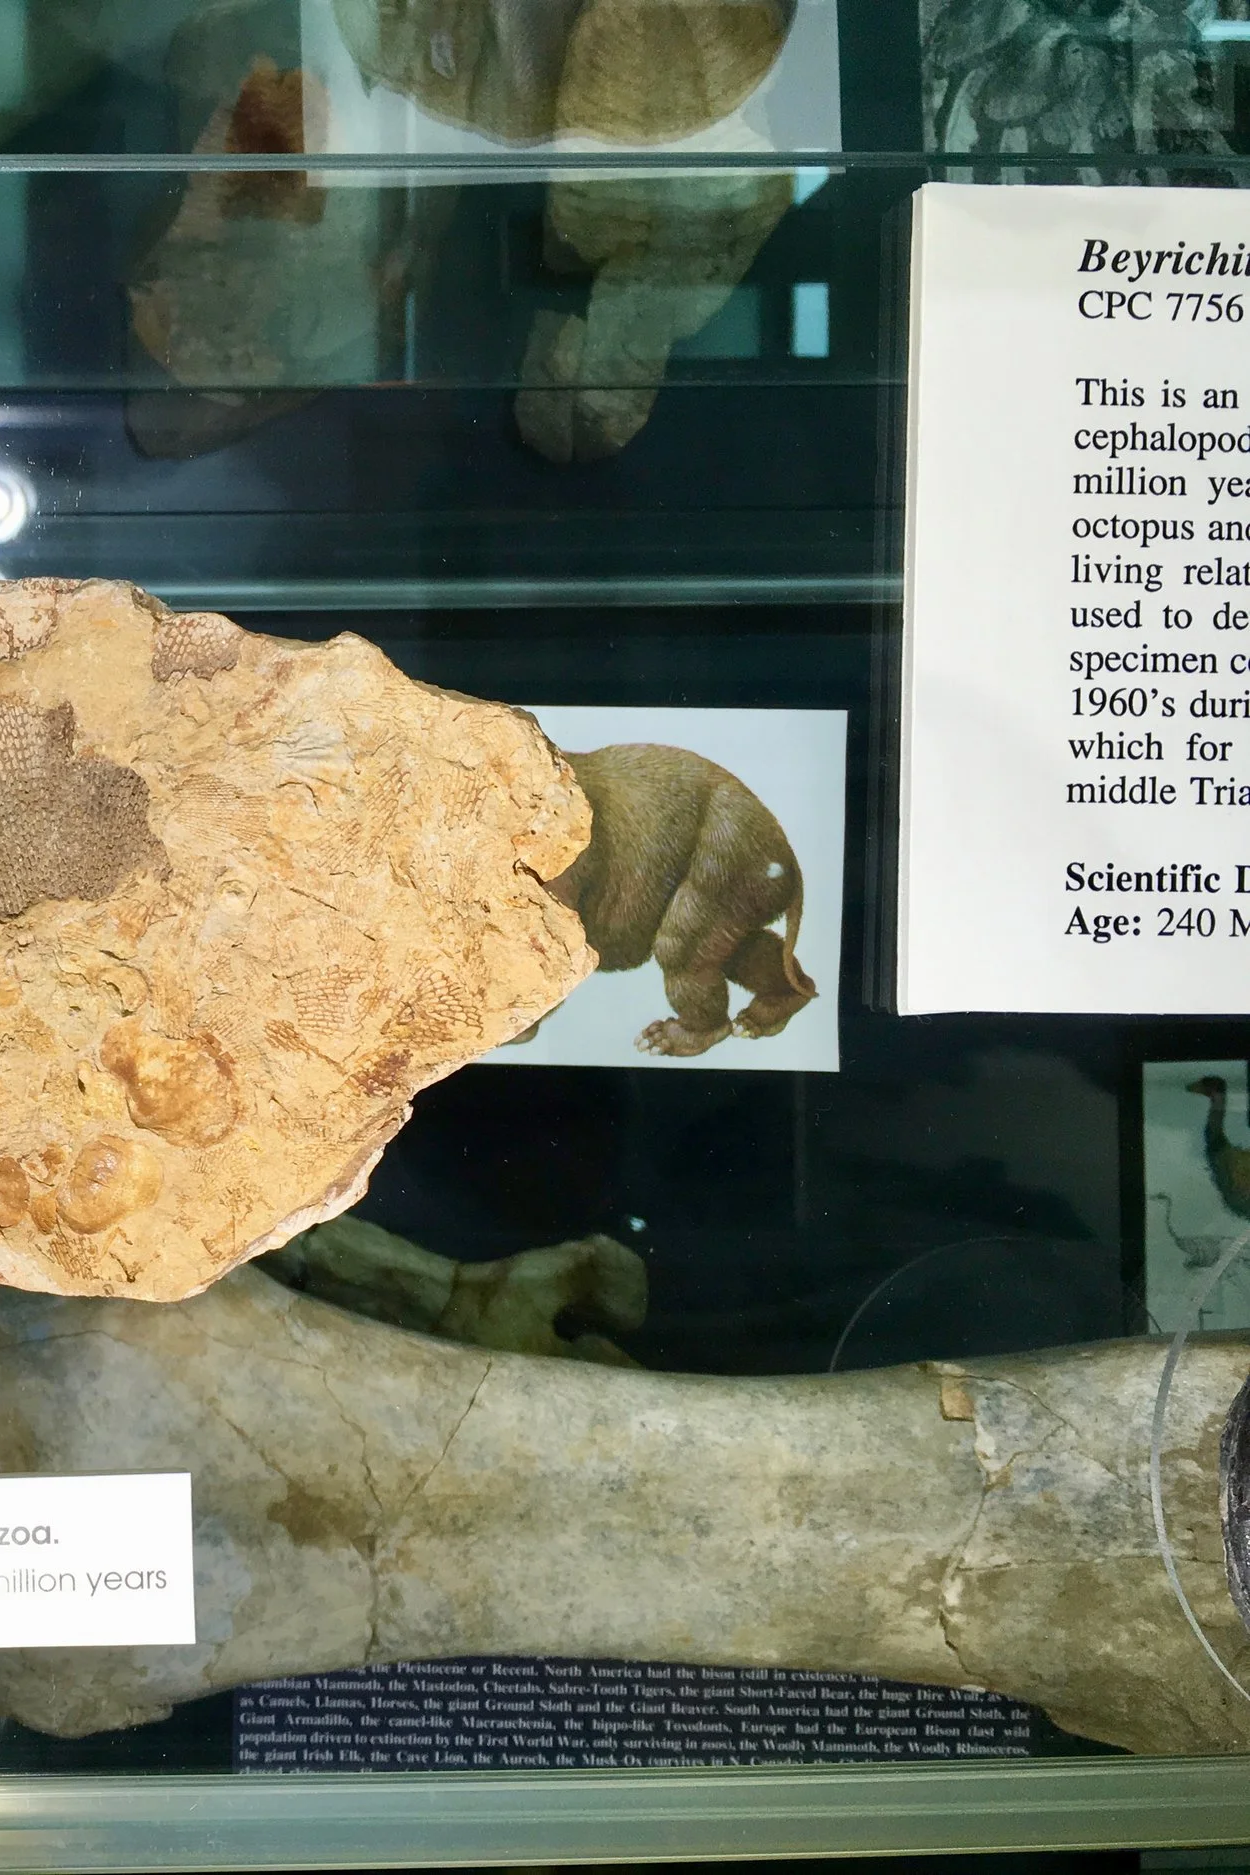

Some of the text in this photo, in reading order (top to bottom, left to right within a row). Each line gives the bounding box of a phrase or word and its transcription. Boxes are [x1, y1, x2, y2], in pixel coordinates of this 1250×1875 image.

[1079, 291, 1243, 322] CPC 7756
[1076, 378, 1238, 408] This is an
[1074, 466, 1186, 495] million
[1073, 515, 1250, 547] octopus an
[1072, 555, 1163, 592] living
[1071, 600, 1142, 628] used
[1163, 606, 1192, 629] to
[1070, 644, 1250, 679] specimen c
[1073, 688, 1250, 718] 1960's duri
[1069, 732, 1232, 761] which for
[1067, 776, 1176, 804] middle
[1066, 863, 1220, 893] Scientific
[1065, 907, 1140, 943] Age:
[1158, 908, 1215, 937] 240
[86, 1566, 168, 1597] years
[472, 1666, 485, 1675] or
[545, 1665, 582, 1677] North
[588, 1665, 642, 1678] America
[647, 1666, 670, 1679] had
[676, 1667, 695, 1679] the
[701, 1668, 735, 1680] bison
[740, 1669, 769, 1682] (still
[774, 1670, 786, 1681] in
[315, 1678, 385, 1692] Mammoth,
[388, 1679, 407, 1691] the
[413, 1680, 479, 1694] Mastodon,
[549, 1683, 628, 1695] Sabre-Tooth
[679, 1684, 699, 1697] the
[703, 1685, 735, 1701] giant
[739, 1686, 816, 1699] Short-Faced
[858, 1688, 879, 1700] the
[882, 1688, 912, 1704] huge
[917, 1689, 945, 1701] Dire
[240, 1697, 254, 1707] as
[259, 1694, 310, 1709] Camels,
[315, 1696, 366, 1710] Llamas,
[371, 1697, 420, 1711] Horses,
[424, 1698, 443, 1710] the
[448, 1698, 479, 1714] giant
[485, 1699, 535, 1711] Ground
[539, 1700, 572, 1712] Sloth
[577, 1701, 600, 1713] and
[605, 1701, 625, 1713] the
[630, 1701, 665, 1714] Giant
[724, 1703, 760, 1715] South
[766, 1704, 820, 1716] America
[824, 1705, 849, 1717] had
[854, 1706, 873, 1717] the
[878, 1706, 910, 1721] giant
[915, 1707, 965, 1719] Ground
[1010, 1708, 1030, 1720] the
[240, 1712, 275, 1724] Giant
[285, 1713, 353, 1727] Armadillo,
[361, 1714, 380, 1726] the
[388, 1715, 453, 1727] camel-like
[564, 1717, 584, 1730] the
[592, 1718, 655, 1734] hippo-like
[741, 1721, 787, 1737] Europe
[795, 1722, 819, 1734] had
[827, 1723, 847, 1735] the
[855, 1723, 917, 1739] European
[925, 1724, 960, 1736] Bison
[968, 1725, 995, 1739] (last
[1004, 1725, 1030, 1737] wild
[239, 1749, 260, 1761] the
[264, 1749, 296, 1765] giant
[304, 1749, 333, 1761] Irish
[370, 1750, 391, 1762] the
[396, 1750, 429, 1763] Cave
[473, 1752, 493, 1764] the
[556, 1754, 576, 1766] the
[240, 1731, 307, 1746] population
[309, 1732, 351, 1744] driven
[355, 1732, 367, 1744] to
[370, 1733, 432, 1745] extinction
[435, 1733, 450, 1749] by
[454, 1734, 474, 1746] the
[478, 1734, 509, 1746] First
[512, 1735, 553, 1747] World
[593, 1736, 618, 1752] only
[622, 1737, 682, 1753] surviving
[685, 1738, 698, 1750] in
[740, 1738, 759, 1750] the
[763, 1739, 806, 1754] Woolly
[811, 1740, 880, 1754] Mammoth,
[884, 1741, 904, 1753] the
[908, 1741, 950, 1757] Woolly
